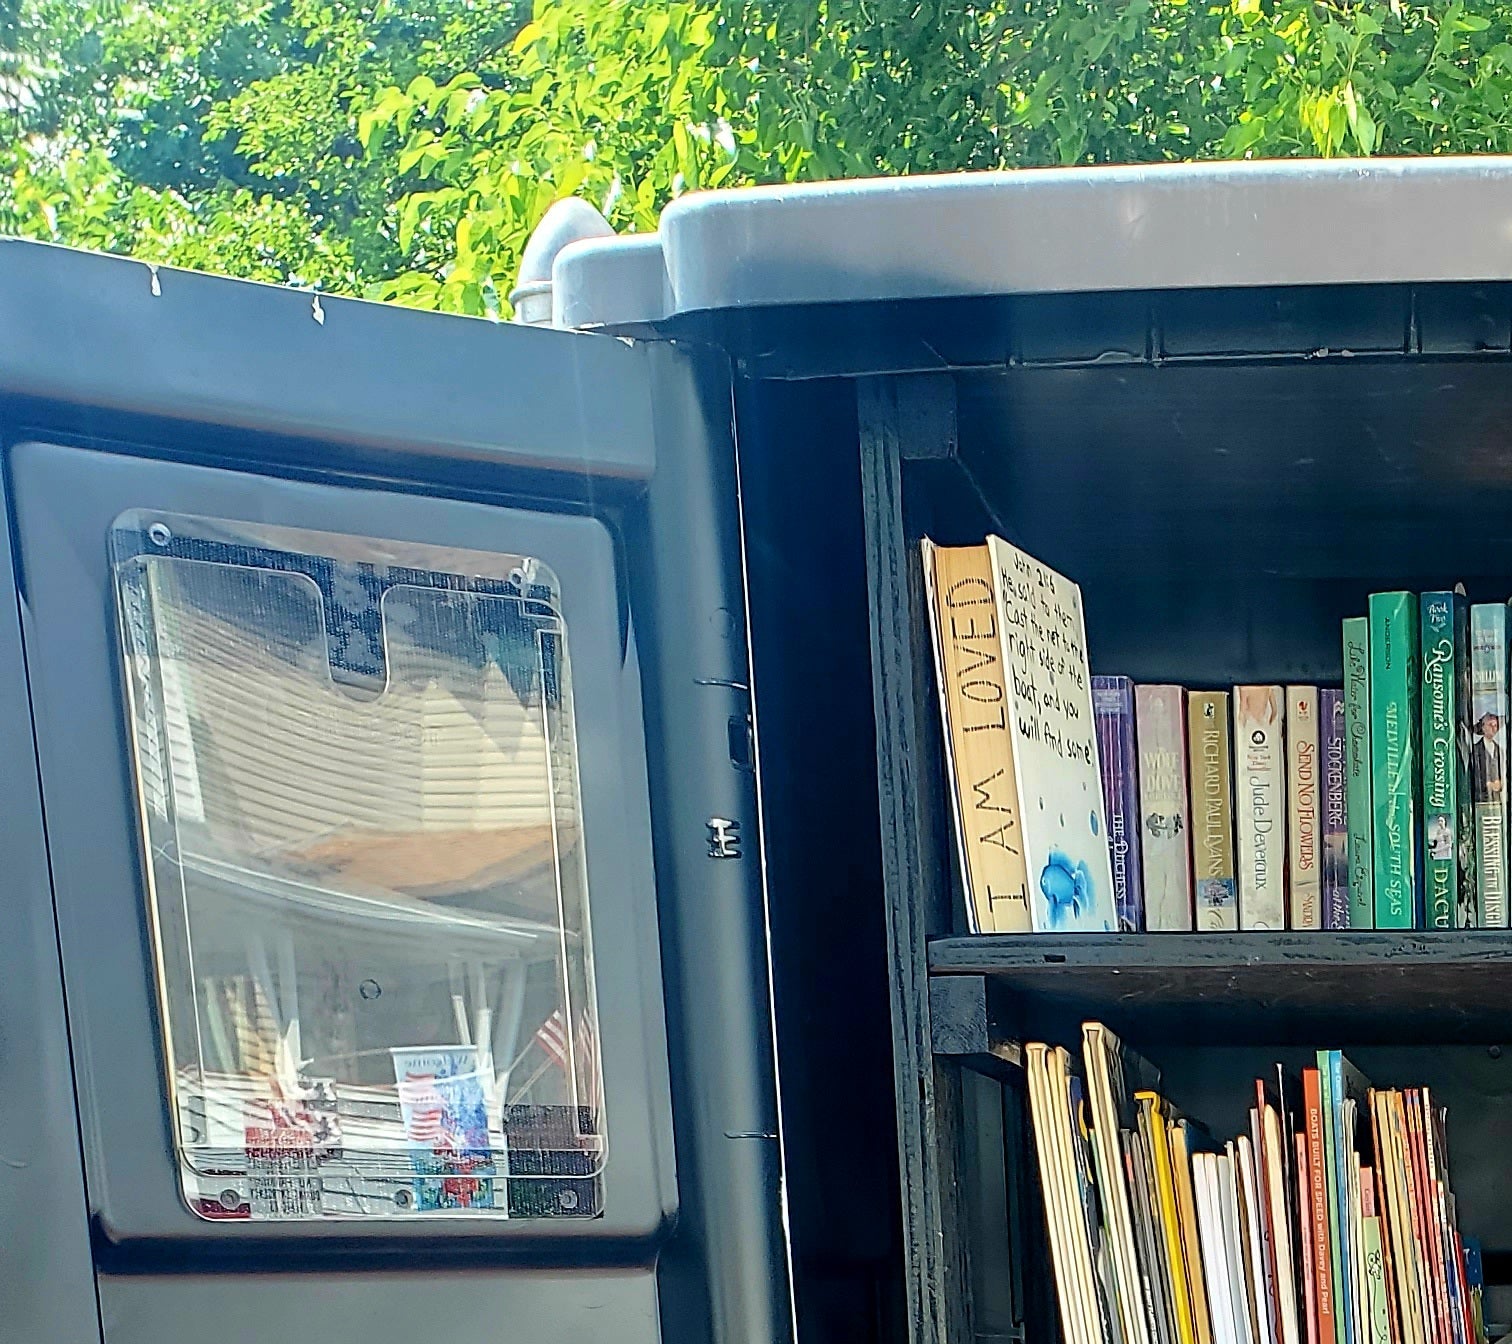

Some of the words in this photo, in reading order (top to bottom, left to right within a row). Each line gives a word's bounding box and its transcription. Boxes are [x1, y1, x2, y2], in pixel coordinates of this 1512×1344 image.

[948, 576, 1005, 733] LOVED
[1008, 632, 1036, 675] right
[1043, 684, 1061, 715] and
[1063, 699, 1078, 720] you
[1424, 639, 1452, 730] Ransome's
[1203, 730, 1220, 796] RICHARD
[1297, 741, 1314, 783] SEND
[1328, 737, 1342, 827] STOCKENBERG
[1431, 737, 1448, 808] Crossing
[973, 769, 1019, 855] AM
[1204, 797, 1223, 831] PAUL
[1250, 776, 1269, 816] Jude
[1298, 784, 1314, 806] NO
[1204, 833, 1224, 877] EVANS
[1254, 818, 1272, 890] Deveraux
[1299, 804, 1314, 871] FLOWERS
[987, 883, 1028, 911] I
[1309, 1108, 1317, 1139] BOATS
[1312, 1139, 1321, 1166] BUILT
[1314, 1168, 1322, 1186] FOR
[1315, 1186, 1323, 1221] SPEED
